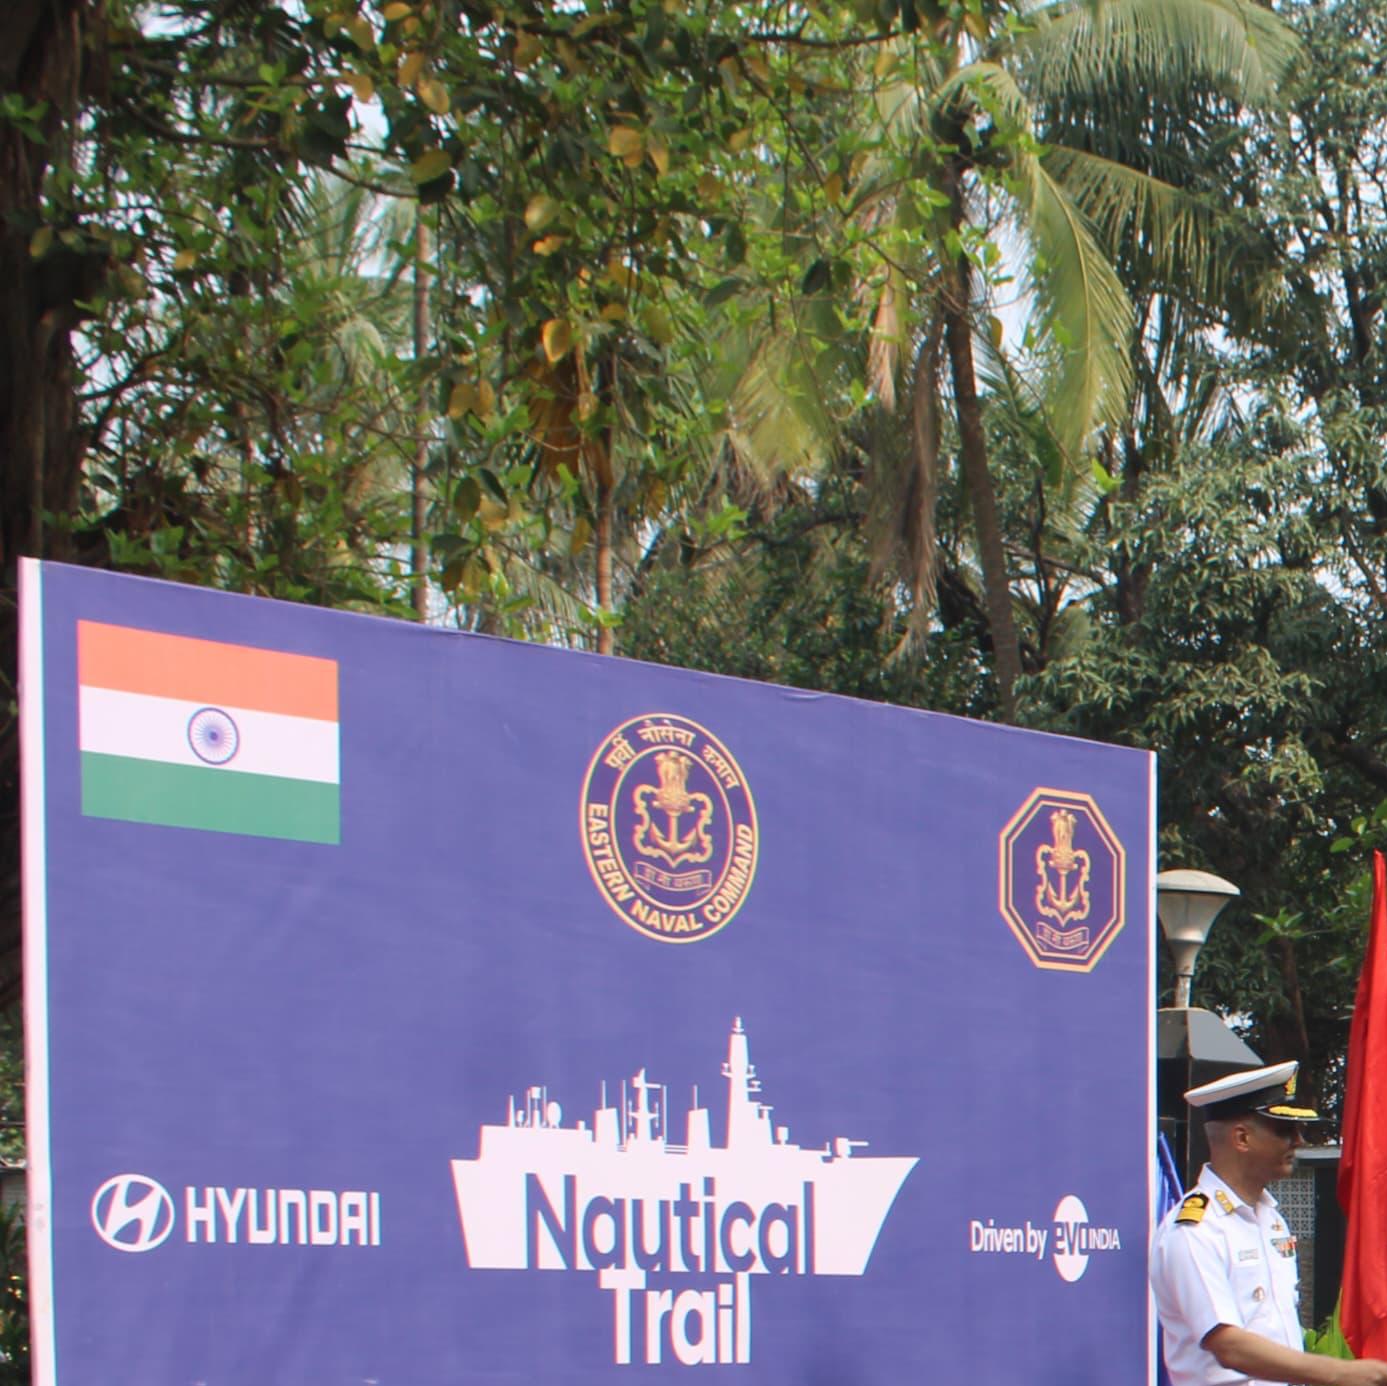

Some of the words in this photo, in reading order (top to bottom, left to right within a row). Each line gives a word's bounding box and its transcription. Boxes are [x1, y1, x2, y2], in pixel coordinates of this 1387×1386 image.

[588, 803, 635, 902] EASTERN
[630, 901, 704, 933] NAVAL
[703, 823, 754, 923] COMMAND
[184, 1185, 381, 1246] HYUNDAI
[525, 1171, 816, 1274] Nautical
[970, 1219, 1024, 1252] Driven
[1026, 1221, 1048, 1260] by
[1089, 1228, 1121, 1250] INDIA
[598, 1270, 751, 1365] Trail
